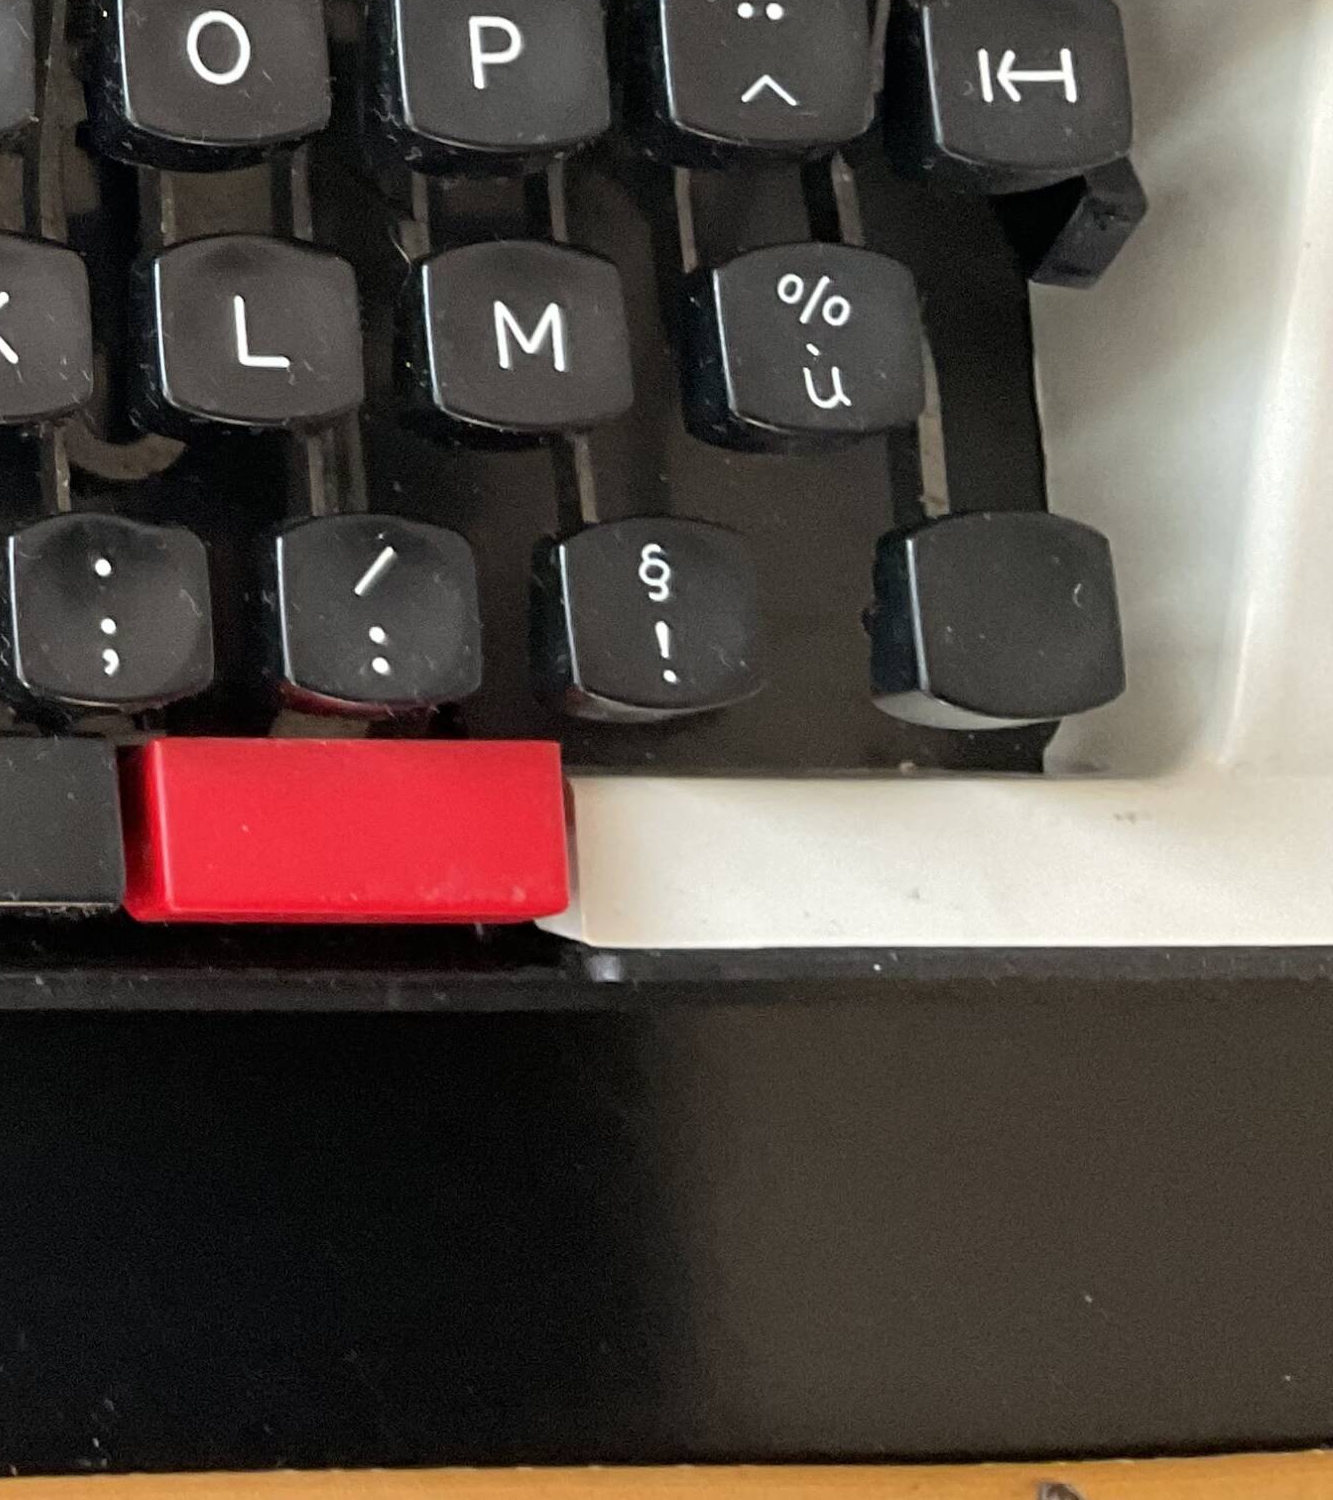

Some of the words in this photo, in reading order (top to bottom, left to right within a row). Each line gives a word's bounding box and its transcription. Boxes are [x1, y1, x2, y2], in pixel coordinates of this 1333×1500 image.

[186, 10, 251, 85] O
[468, 15, 522, 90] P
[777, 273, 851, 326] %
[233, 295, 291, 368] L
[493, 300, 566, 372] M
[803, 343, 852, 409] ù
[354, 546, 394, 596] /
[638, 543, 671, 602] §
[100, 618, 120, 676] ;
[368, 626, 390, 675] :
[655, 620, 678, 683] !
